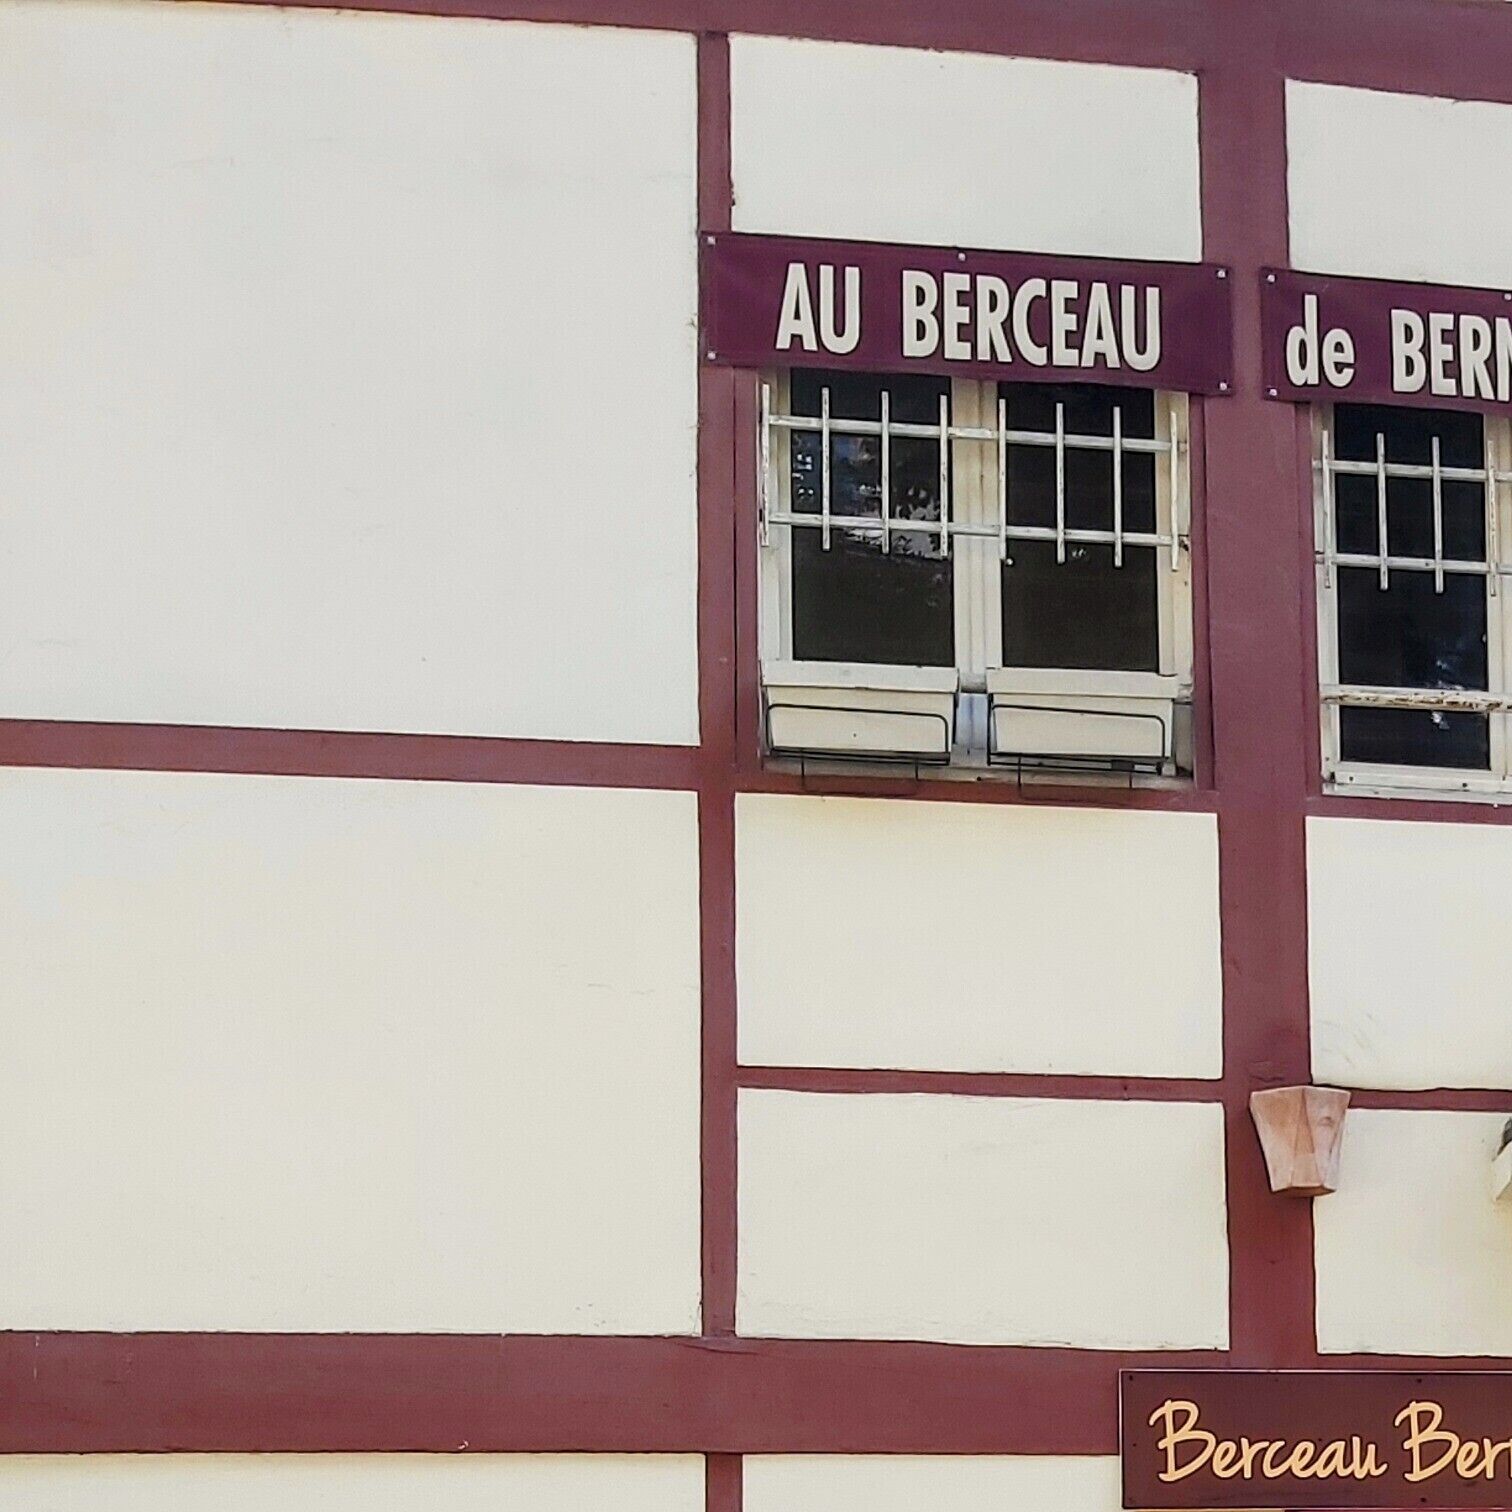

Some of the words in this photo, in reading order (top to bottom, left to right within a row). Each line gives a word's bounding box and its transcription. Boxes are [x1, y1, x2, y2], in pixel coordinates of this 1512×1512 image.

[775, 262, 863, 355] AU
[902, 269, 1162, 373] BERCEAU
[1285, 294, 1356, 387] de
[1148, 1396, 1388, 1484] Berceau
